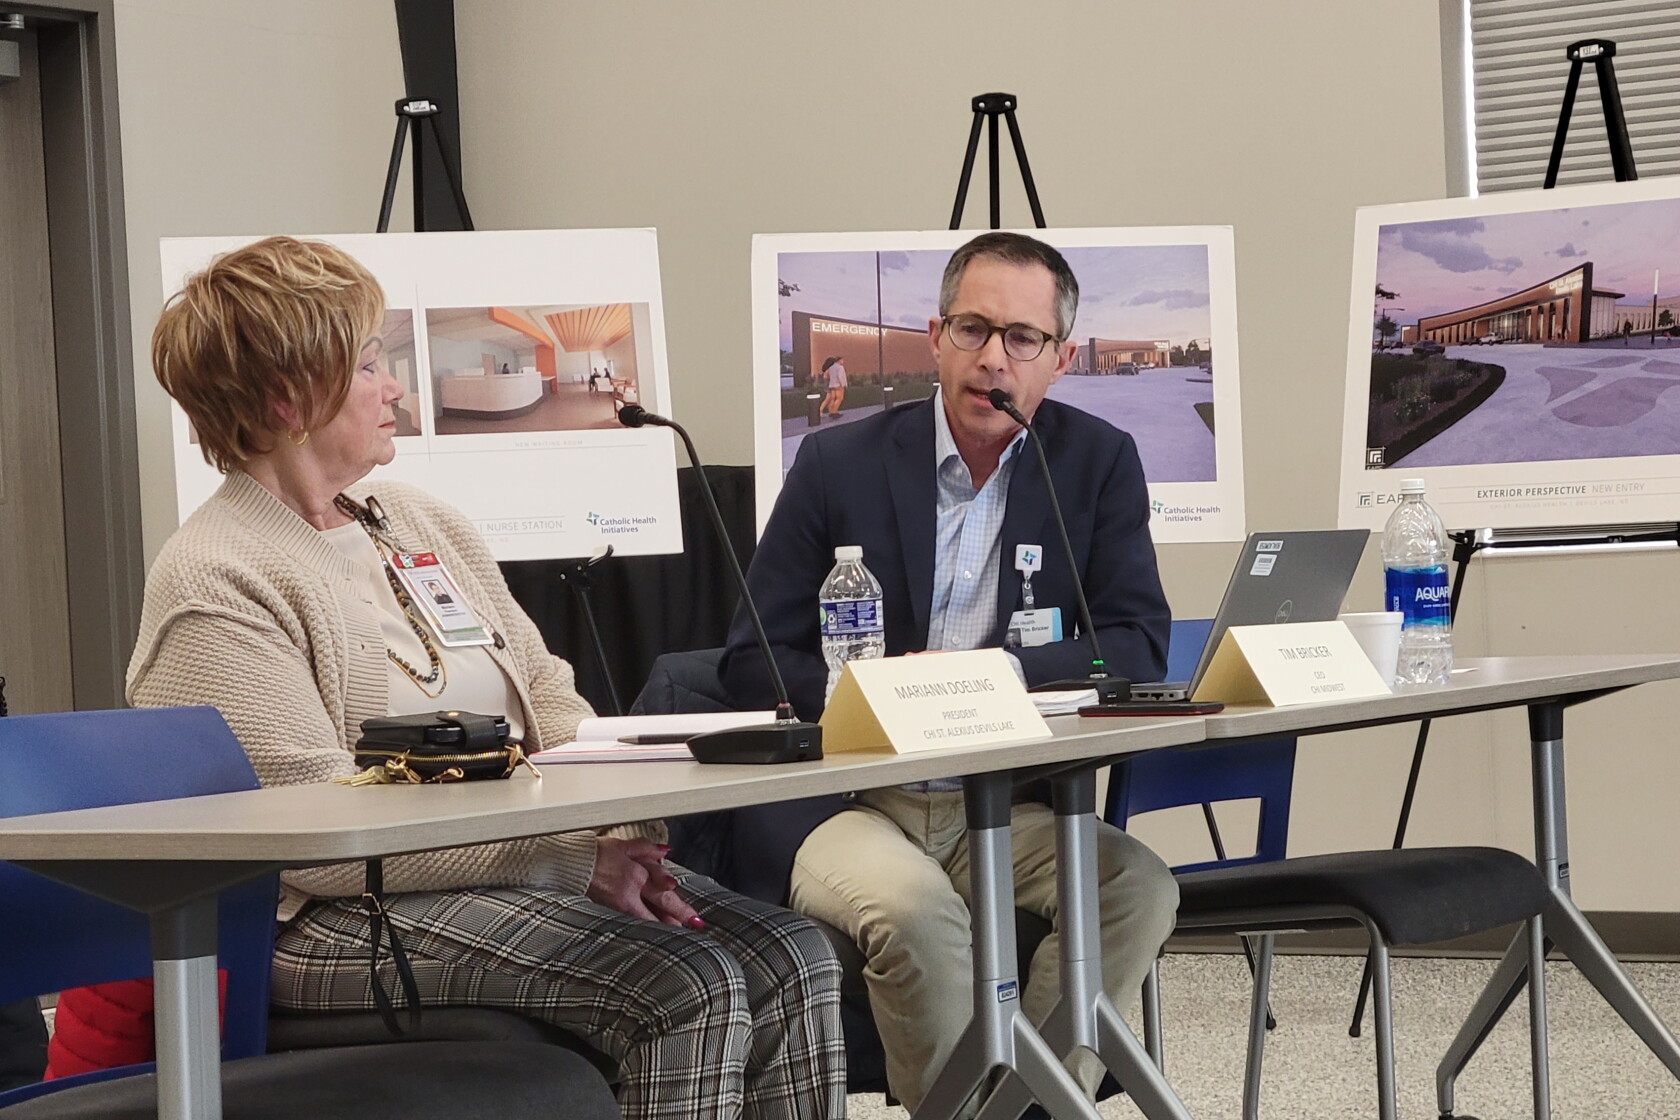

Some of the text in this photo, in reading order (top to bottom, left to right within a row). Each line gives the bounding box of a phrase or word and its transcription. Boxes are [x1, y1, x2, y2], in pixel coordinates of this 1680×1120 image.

[812, 322, 888, 336] EMERGENCY
[1477, 482, 1645, 498] EXTERIOR PERSPECTIVE NEW ENTRY
[1376, 494, 1405, 504] EAP
[1164, 506, 1221, 514] Catholic Health
[600, 516, 657, 526] Catholic Health
[1164, 514, 1202, 522] Initiatives
[486, 519, 564, 532] NURSE STATION
[601, 525, 639, 534] Initiatives
[1278, 645, 1333, 660] TIM BRICKER
[1314, 671, 1326, 679] CEO
[894, 678, 995, 700] MARIANN DOELING
[1310, 683, 1346, 694] CHI MIDWEST
[942, 708, 978, 720] PRESIDENT
[923, 720, 1015, 740] CHI ST. ALEXIUS DEVILS LAKE
